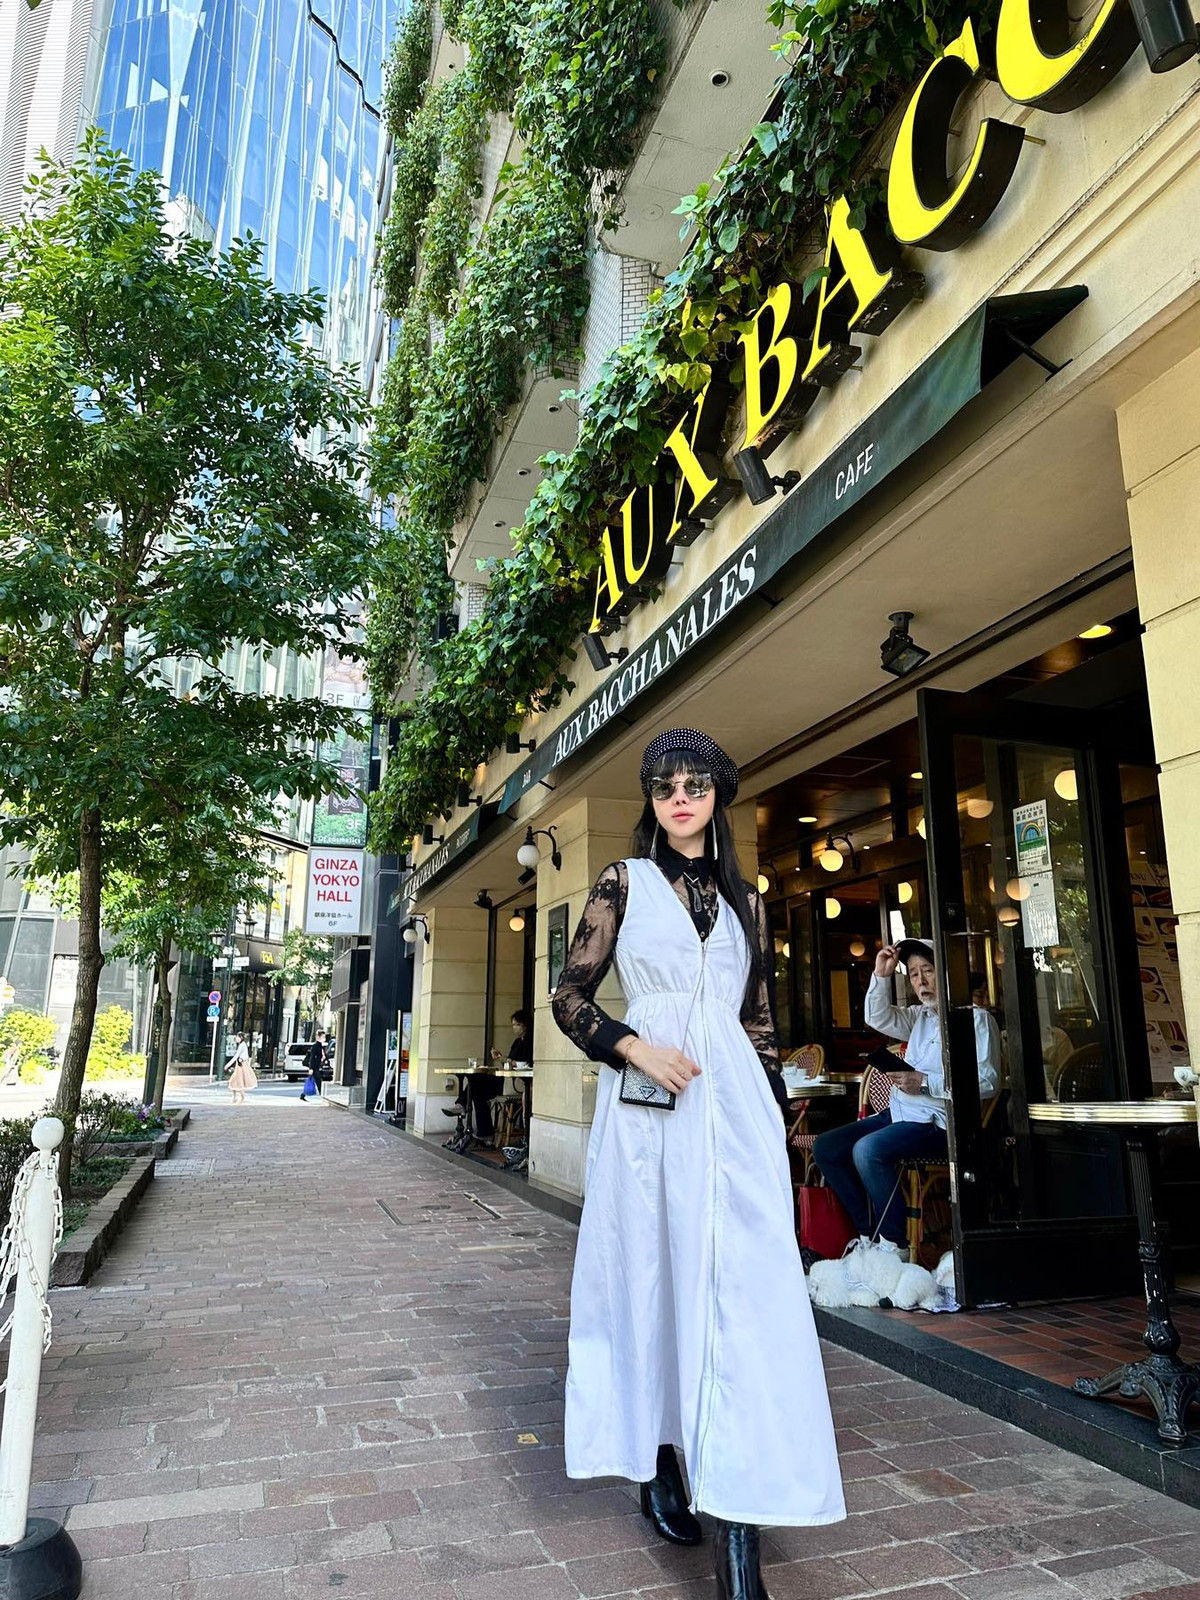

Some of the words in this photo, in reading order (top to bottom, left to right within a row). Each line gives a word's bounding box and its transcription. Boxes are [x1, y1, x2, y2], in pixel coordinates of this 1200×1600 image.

[835, 443, 874, 500] CAFE
[588, 381, 718, 634] AUX
[552, 710, 586, 767] AUX
[585, 545, 757, 738] BACCHANALES
[326, 693, 344, 704] 3F
[346, 818, 362, 830] 3F
[314, 858, 358, 871] GINZA
[313, 874, 360, 887] YOKYO
[317, 890, 352, 903] HALL
